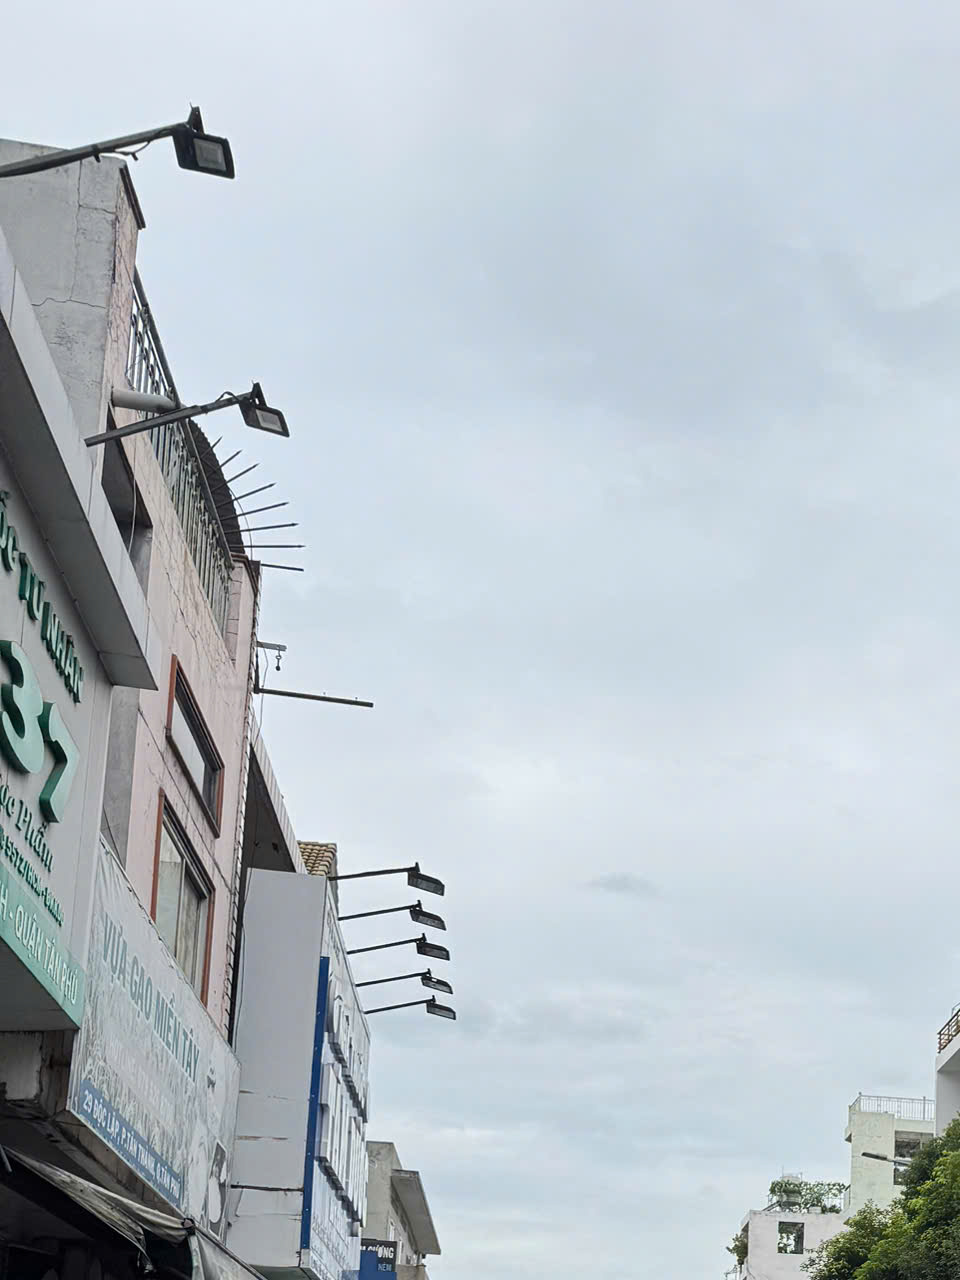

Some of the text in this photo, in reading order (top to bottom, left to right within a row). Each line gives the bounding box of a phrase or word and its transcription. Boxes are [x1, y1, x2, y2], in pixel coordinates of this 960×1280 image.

[15, 908, 43, 960] QUẬN
[60, 966, 78, 1005] PHÚ
[103, 911, 201, 1083] VỰA GẠO MIỀN TÂY
[83, 1089, 94, 1113] 29
